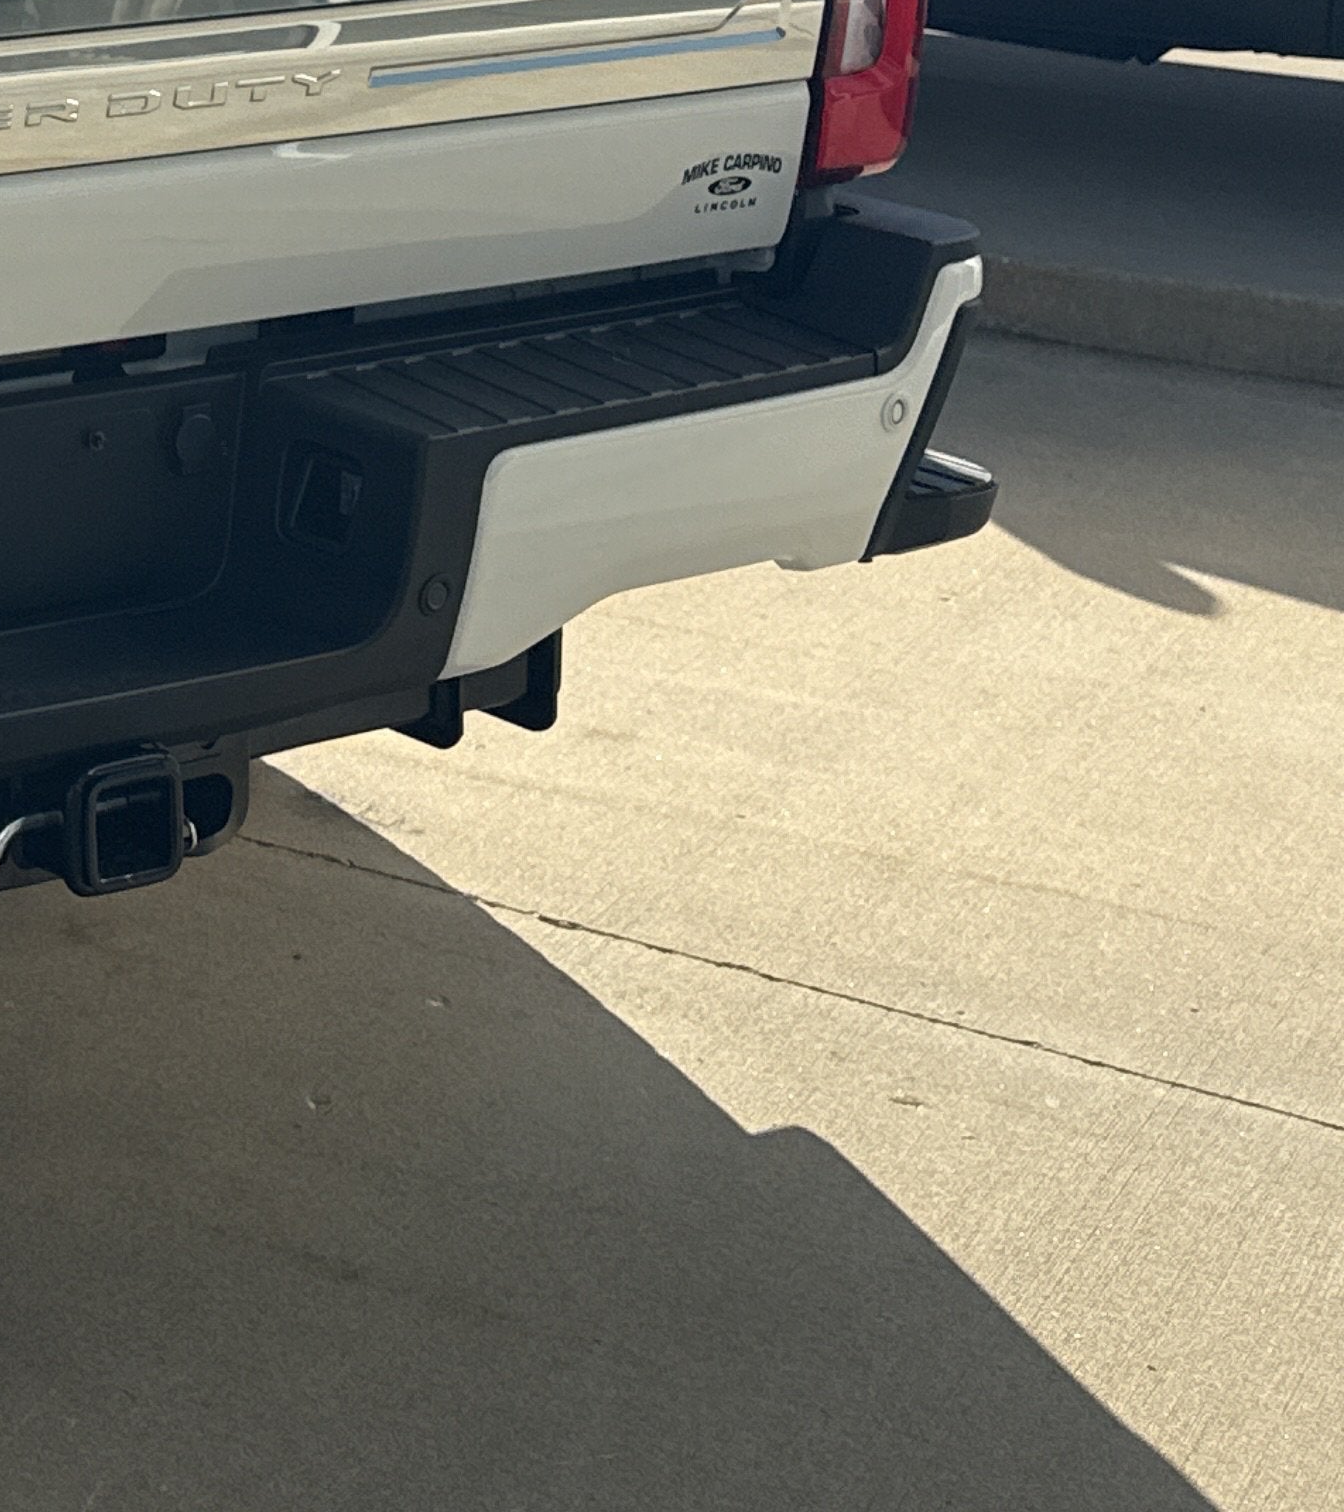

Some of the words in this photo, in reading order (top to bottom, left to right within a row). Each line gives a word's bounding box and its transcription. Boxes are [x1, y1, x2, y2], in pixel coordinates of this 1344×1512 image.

[106, 69, 342, 118] DUTY
[681, 158, 720, 186] MIKE
[723, 153, 782, 174] CARPINO
[694, 197, 757, 214] LINCOLN
